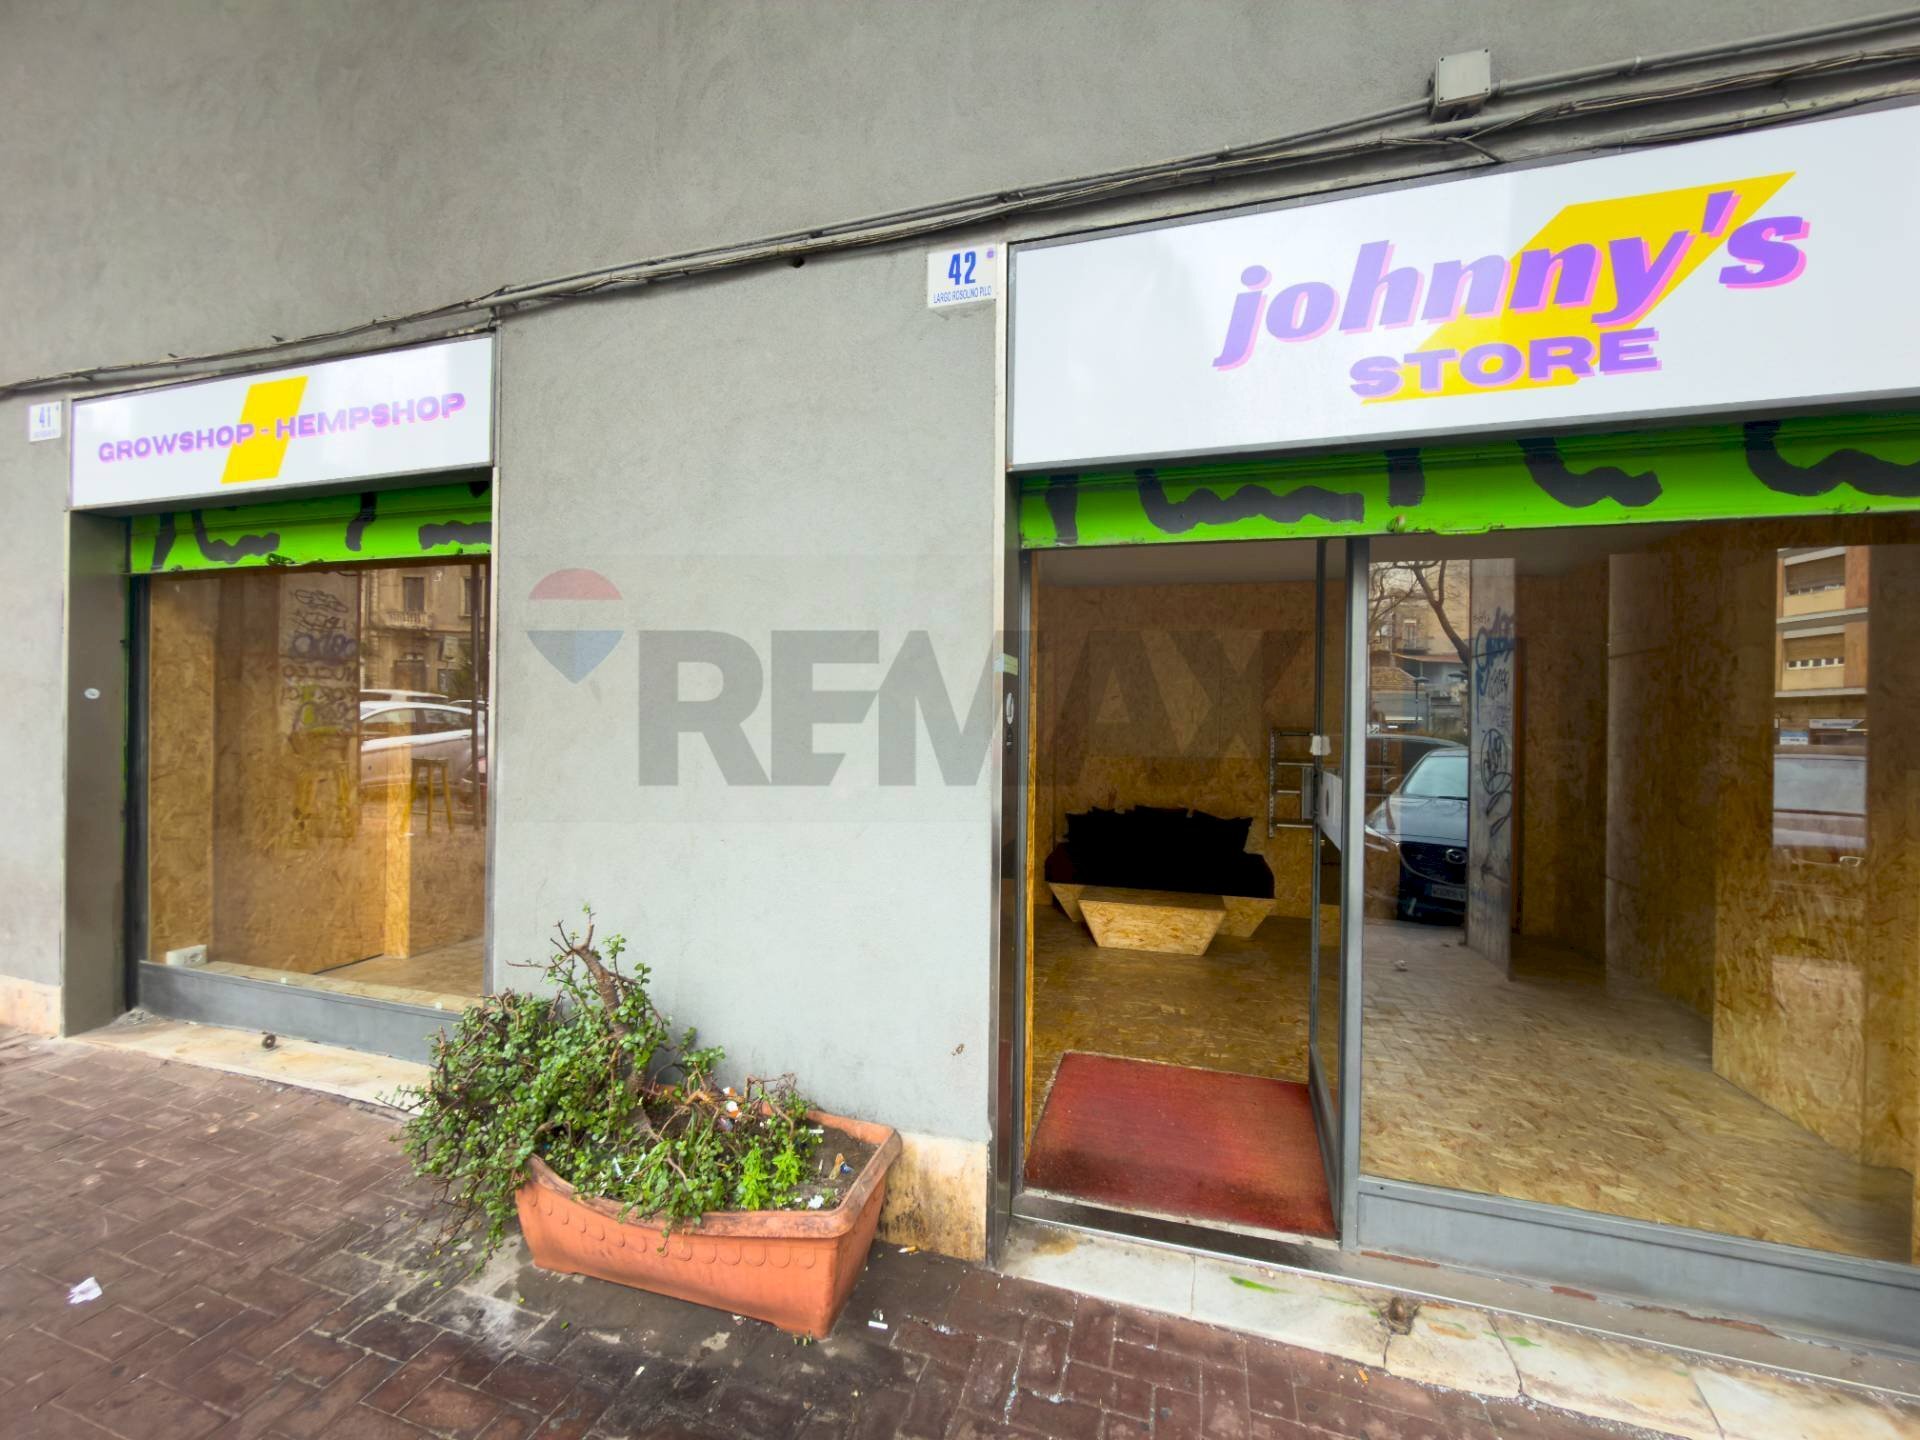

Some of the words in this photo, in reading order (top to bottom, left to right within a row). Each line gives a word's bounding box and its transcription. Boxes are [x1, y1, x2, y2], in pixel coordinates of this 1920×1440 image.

[948, 251, 977, 285] 42
[1212, 190, 1810, 370] johnny's
[1349, 327, 1662, 399] STORE
[98, 423, 255, 463] GROWSHOP
[275, 392, 467, 440] HEMPSHOP
